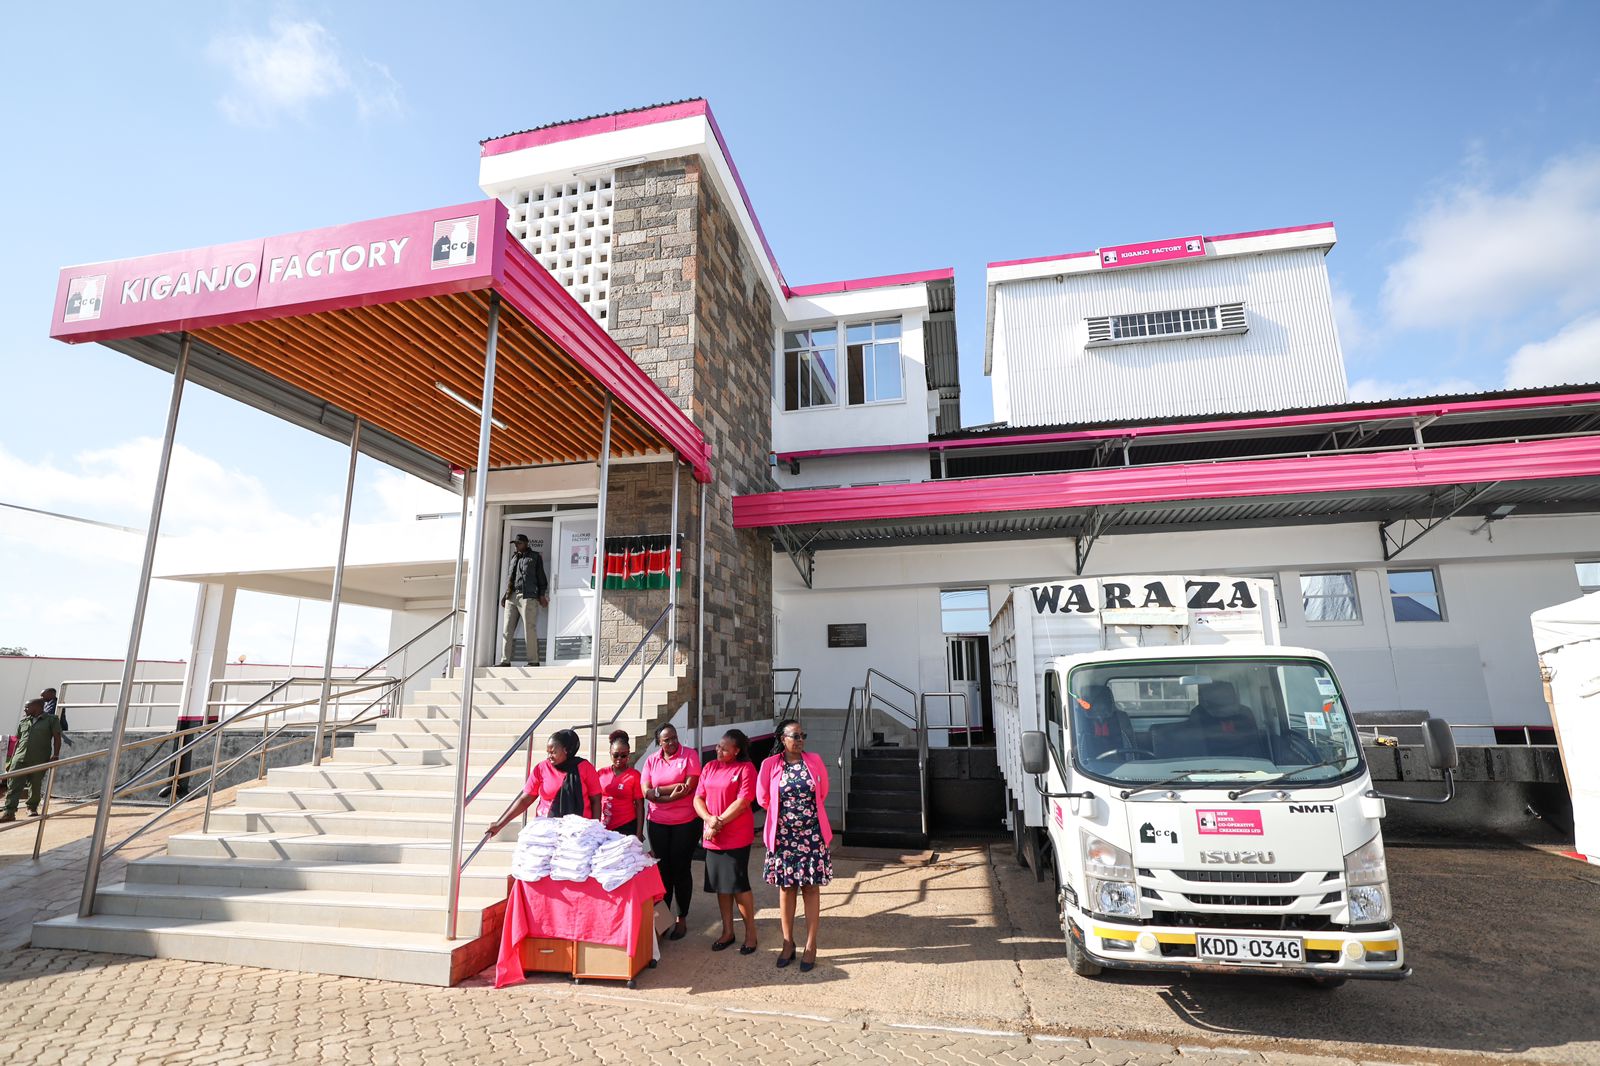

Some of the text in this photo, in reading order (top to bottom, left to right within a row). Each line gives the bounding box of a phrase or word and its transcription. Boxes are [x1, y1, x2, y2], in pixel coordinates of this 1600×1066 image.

[441, 242, 467, 253] KCC
[1121, 249, 1150, 258] KIGANJO
[1152, 245, 1182, 254] FACTORY
[120, 237, 409, 305] KIGANJO FACTORY
[1031, 580, 1257, 614] WARAZA
[1289, 805, 1334, 813] NMR
[1200, 851, 1276, 864] ISUZU
[1200, 937, 1300, 958] KDD 034G
